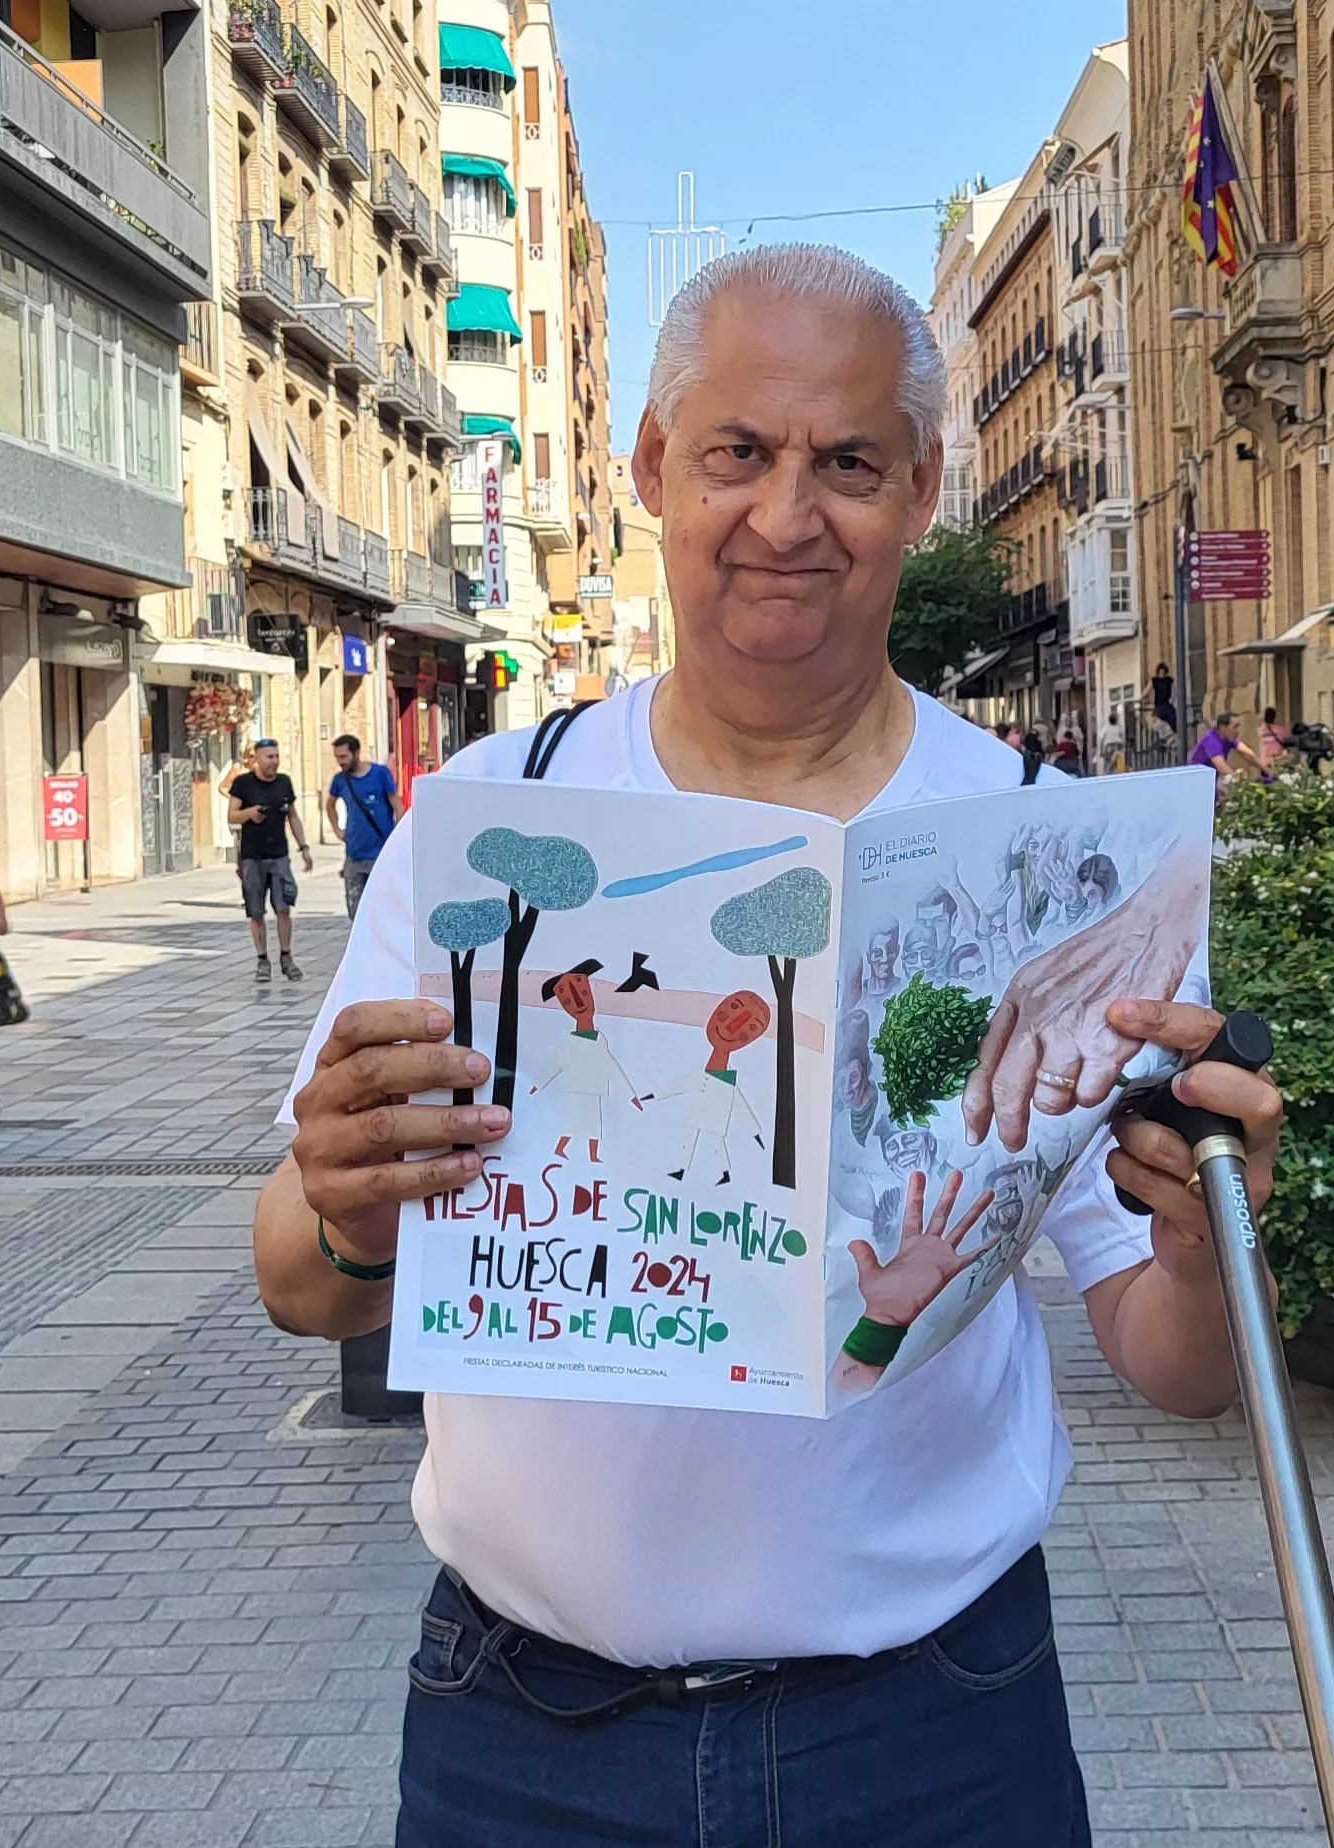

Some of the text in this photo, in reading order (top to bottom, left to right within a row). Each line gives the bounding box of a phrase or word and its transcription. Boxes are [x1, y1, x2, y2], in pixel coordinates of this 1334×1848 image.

[484, 446, 501, 605] FARMACIA
[579, 575, 612, 592] DUVISA
[885, 831, 937, 852] EL DIARIO
[885, 846, 938, 865] DE HUESCA
[571, 1179, 608, 1222] DE
[616, 1187, 680, 1245] SAN
[690, 1200, 808, 1265] LORENZO
[469, 1235, 711, 1303] HUESCA 2024
[422, 1293, 729, 1355] DEL 9 AL 15 DE AGOSTO
[463, 1356, 669, 1378] FIESTAS DECLARADAS DE INTERÉS TURÍSTICO NACIONAL
[748, 1366, 804, 1381] Ayuntamiento
[748, 1376, 790, 1387] de Huesca
